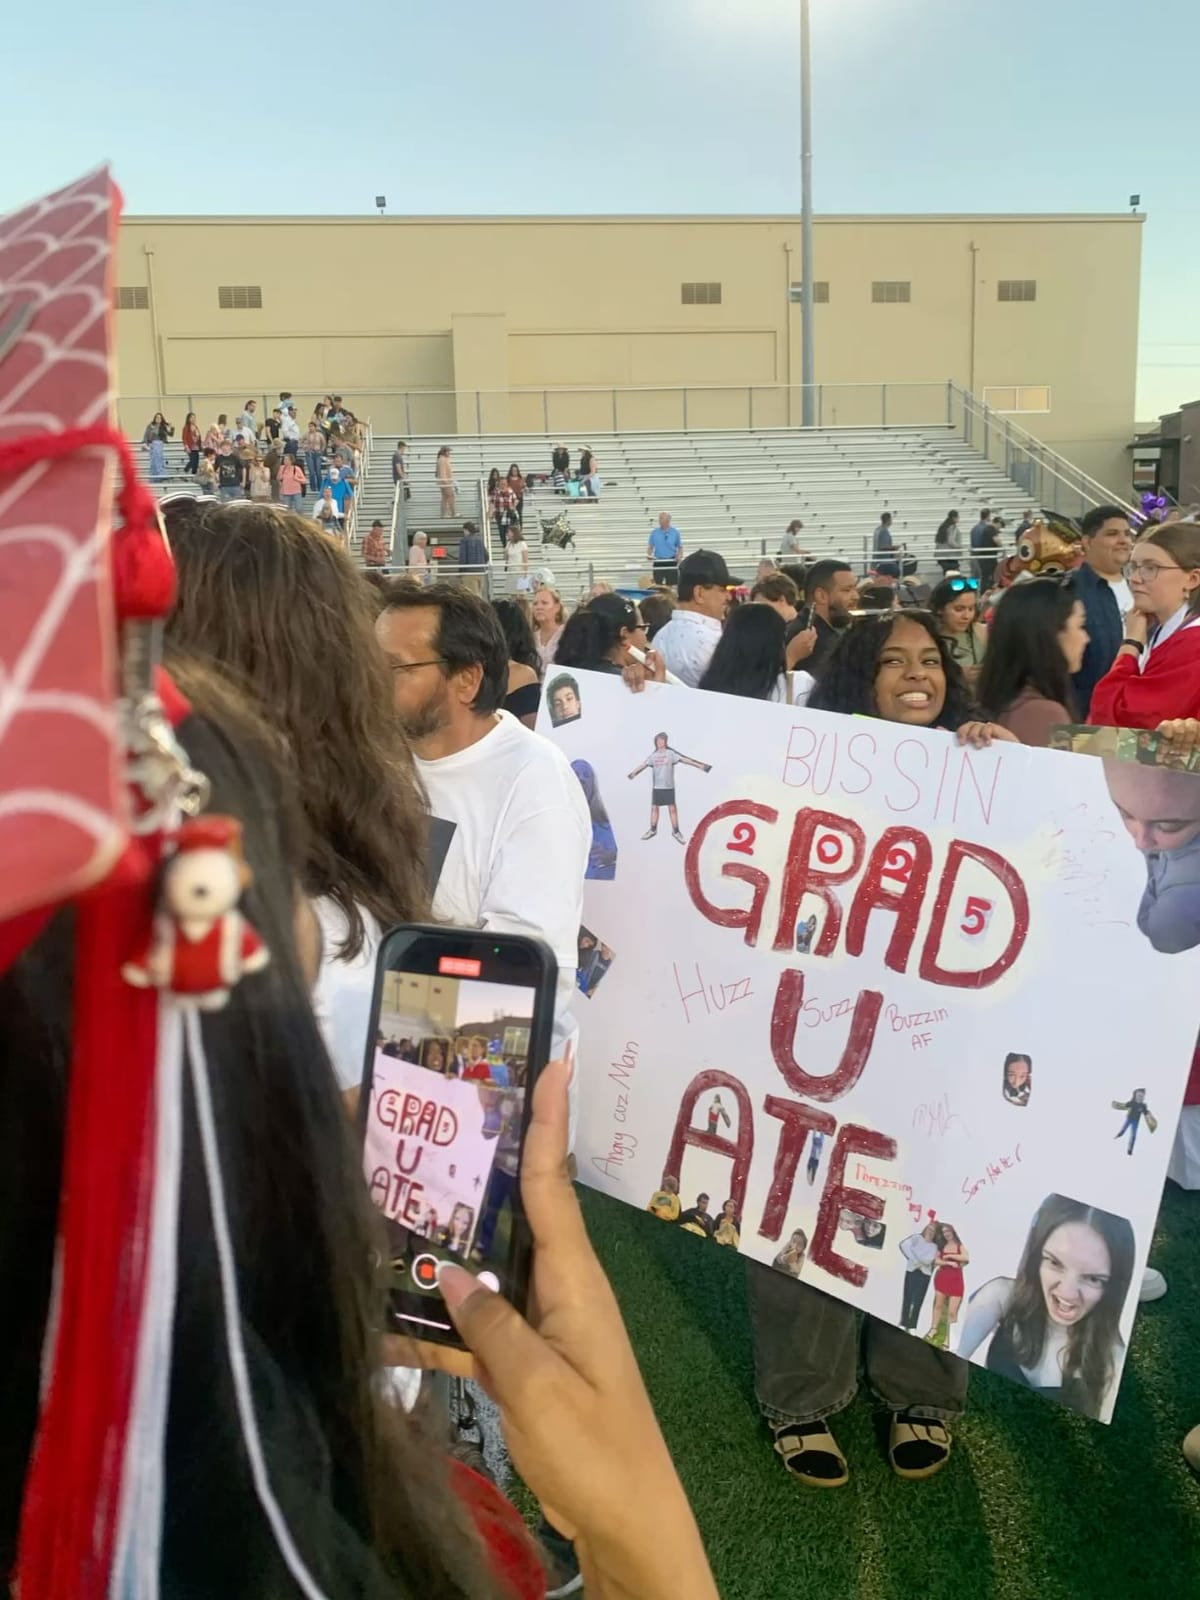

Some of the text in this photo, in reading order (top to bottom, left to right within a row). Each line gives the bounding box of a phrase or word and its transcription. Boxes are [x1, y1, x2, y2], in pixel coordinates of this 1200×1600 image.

[782, 725, 1002, 824] BUSSIN
[685, 799, 1030, 988] GRAD
[770, 968, 884, 1102] U
[911, 1032, 932, 1050] AF
[377, 1089, 458, 1146] GRAD
[396, 1139, 422, 1174] U
[370, 1166, 424, 1224] ATE
[661, 1069, 897, 1288] ATE
